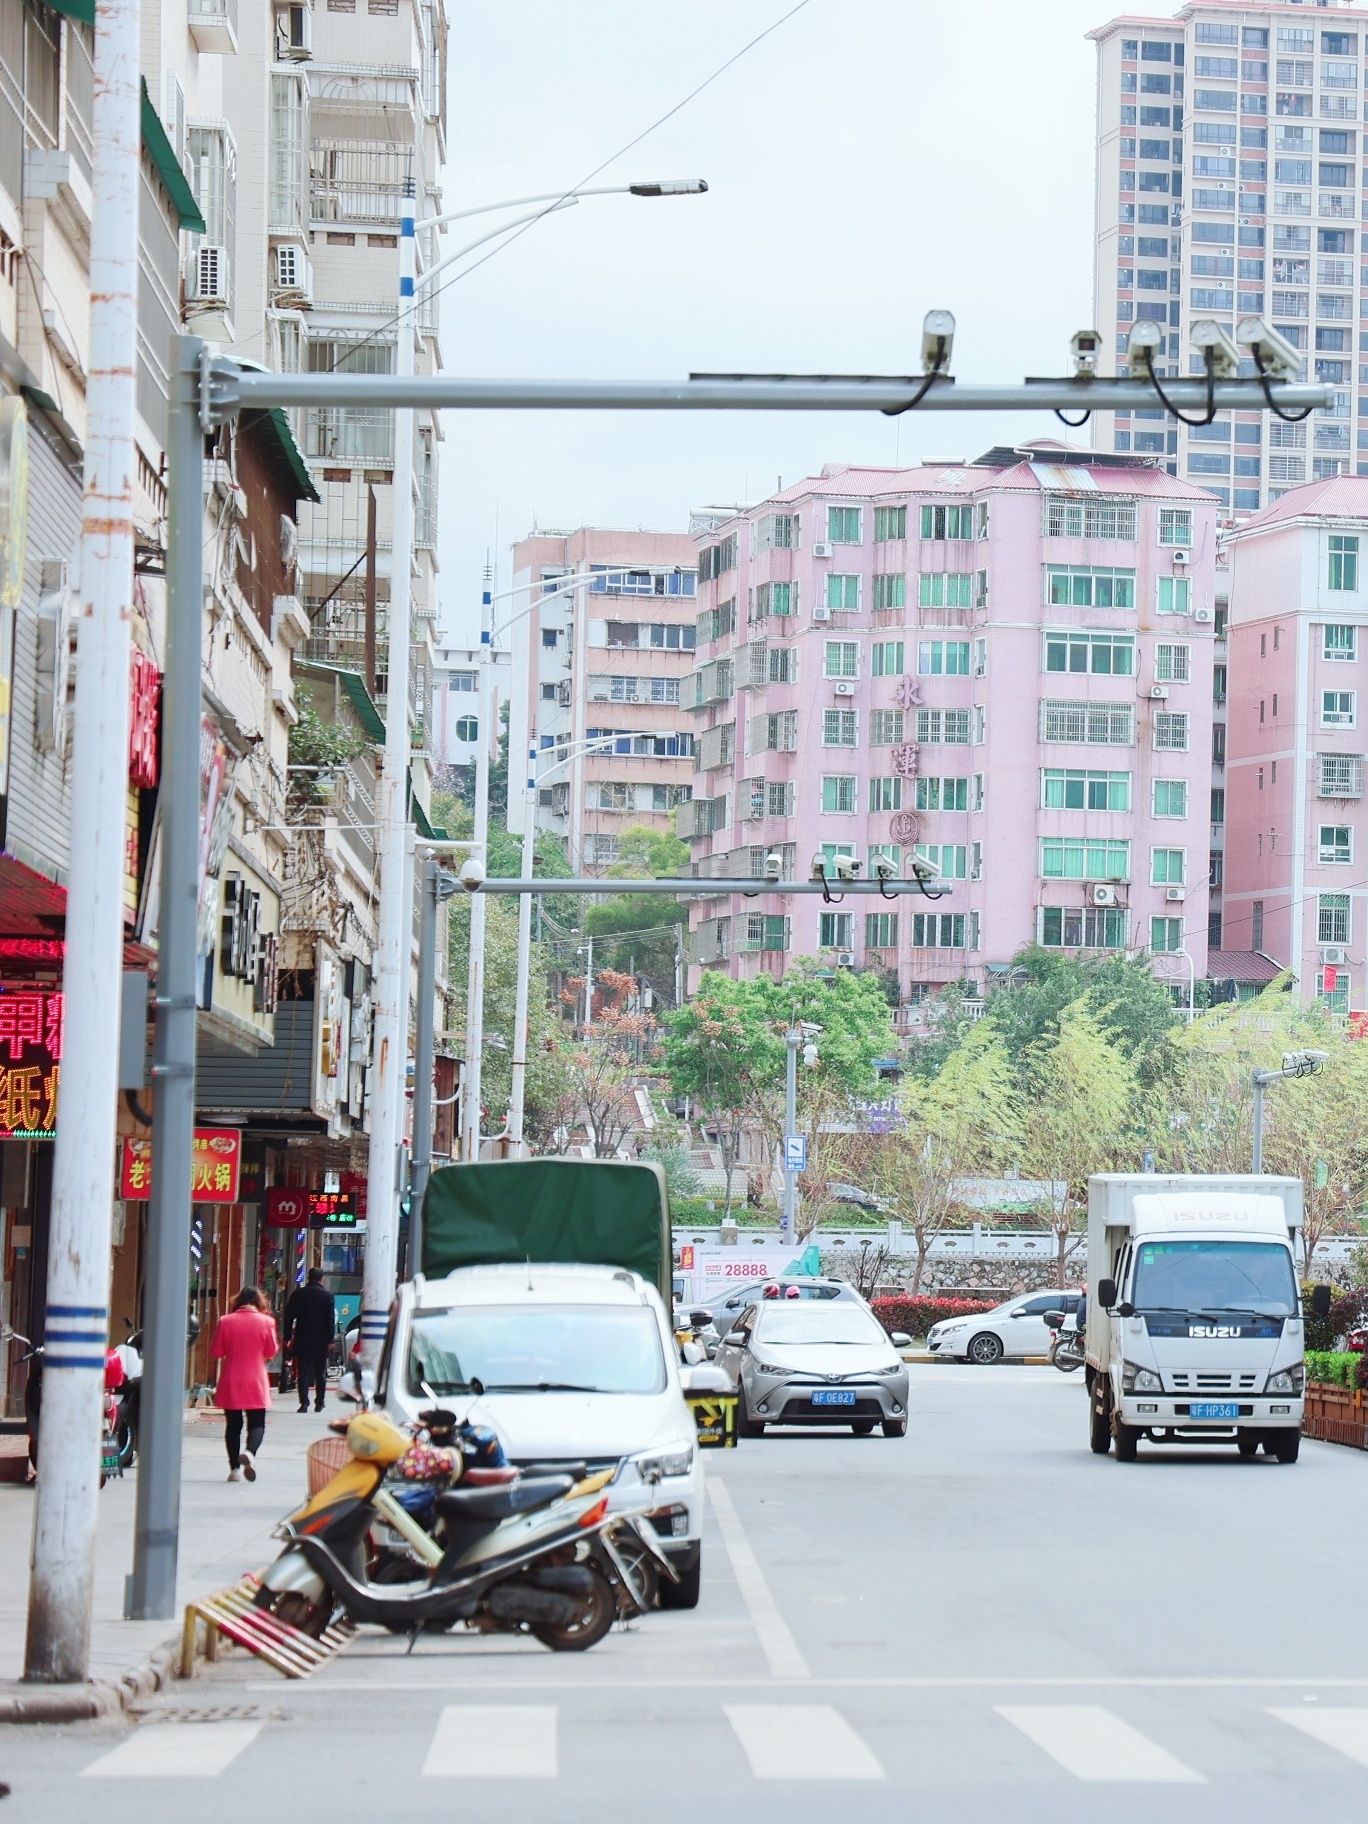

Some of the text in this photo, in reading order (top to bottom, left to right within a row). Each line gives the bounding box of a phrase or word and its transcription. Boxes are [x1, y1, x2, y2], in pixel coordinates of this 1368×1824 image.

[1173, 1211, 1249, 1222] ISUZU
[725, 1264, 767, 1276] 28888
[1188, 1325, 1241, 1337] ISUZU
